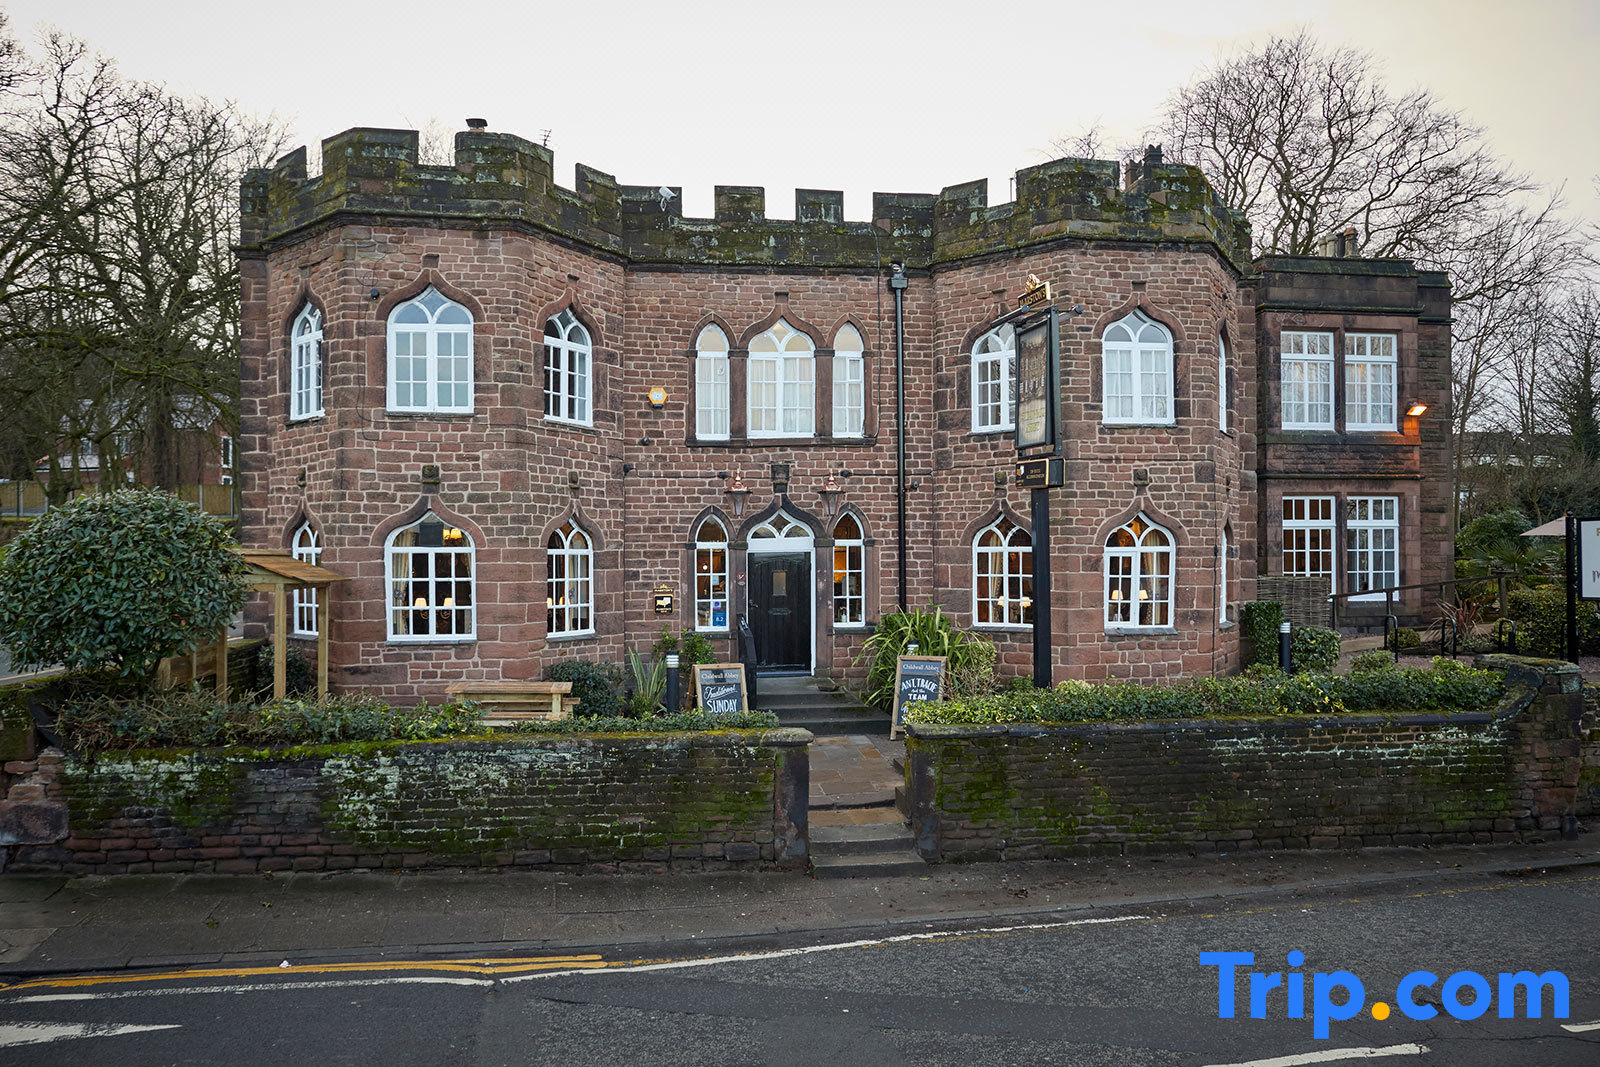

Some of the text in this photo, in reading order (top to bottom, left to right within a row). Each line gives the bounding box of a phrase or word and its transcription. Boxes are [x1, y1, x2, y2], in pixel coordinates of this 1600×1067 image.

[724, 672, 739, 680] Abbey
[916, 678, 938, 693] TRACIE
[706, 699, 738, 713] SUNDAY
